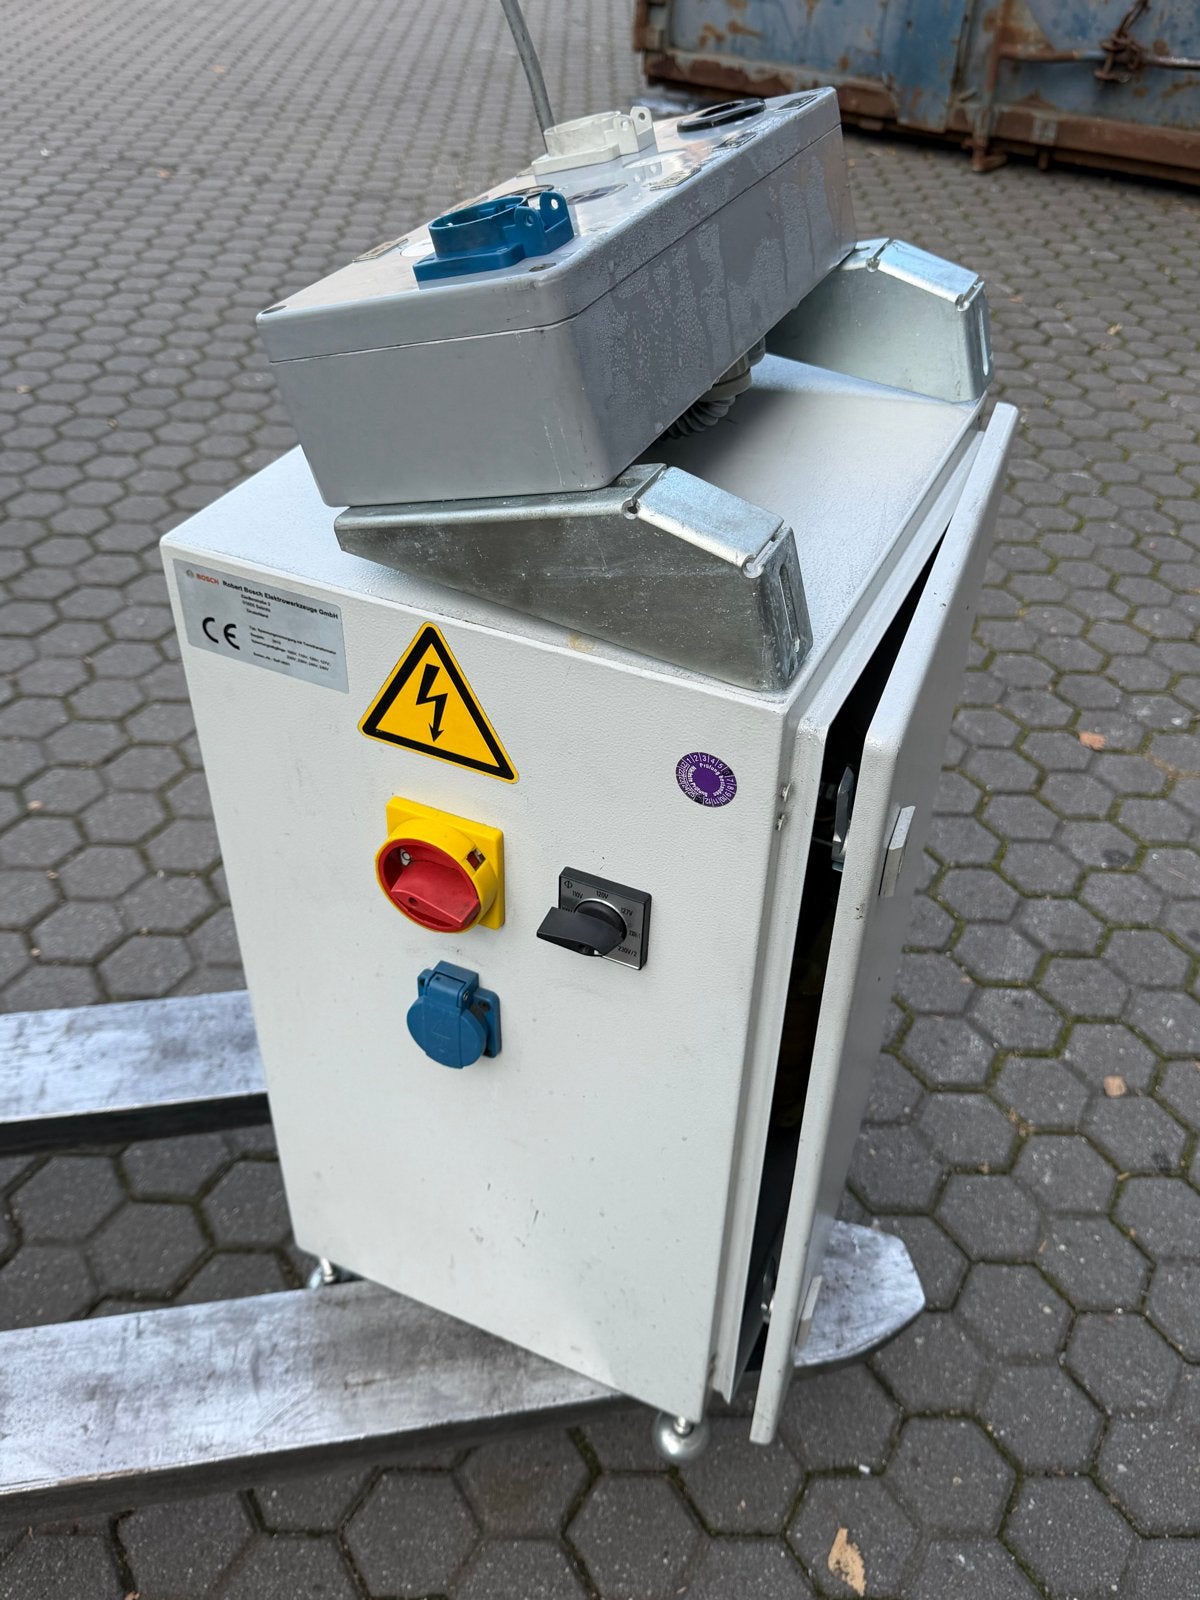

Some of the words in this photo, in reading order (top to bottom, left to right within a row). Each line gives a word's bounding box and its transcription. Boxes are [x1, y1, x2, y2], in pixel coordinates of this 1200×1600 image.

[196, 573, 219, 585] BOSCH
[222, 580, 243, 591] Robert
[244, 586, 264, 597] Bosch
[264, 592, 318, 613] Elektrowerkzeuge
[319, 608, 339, 619] GmbH
